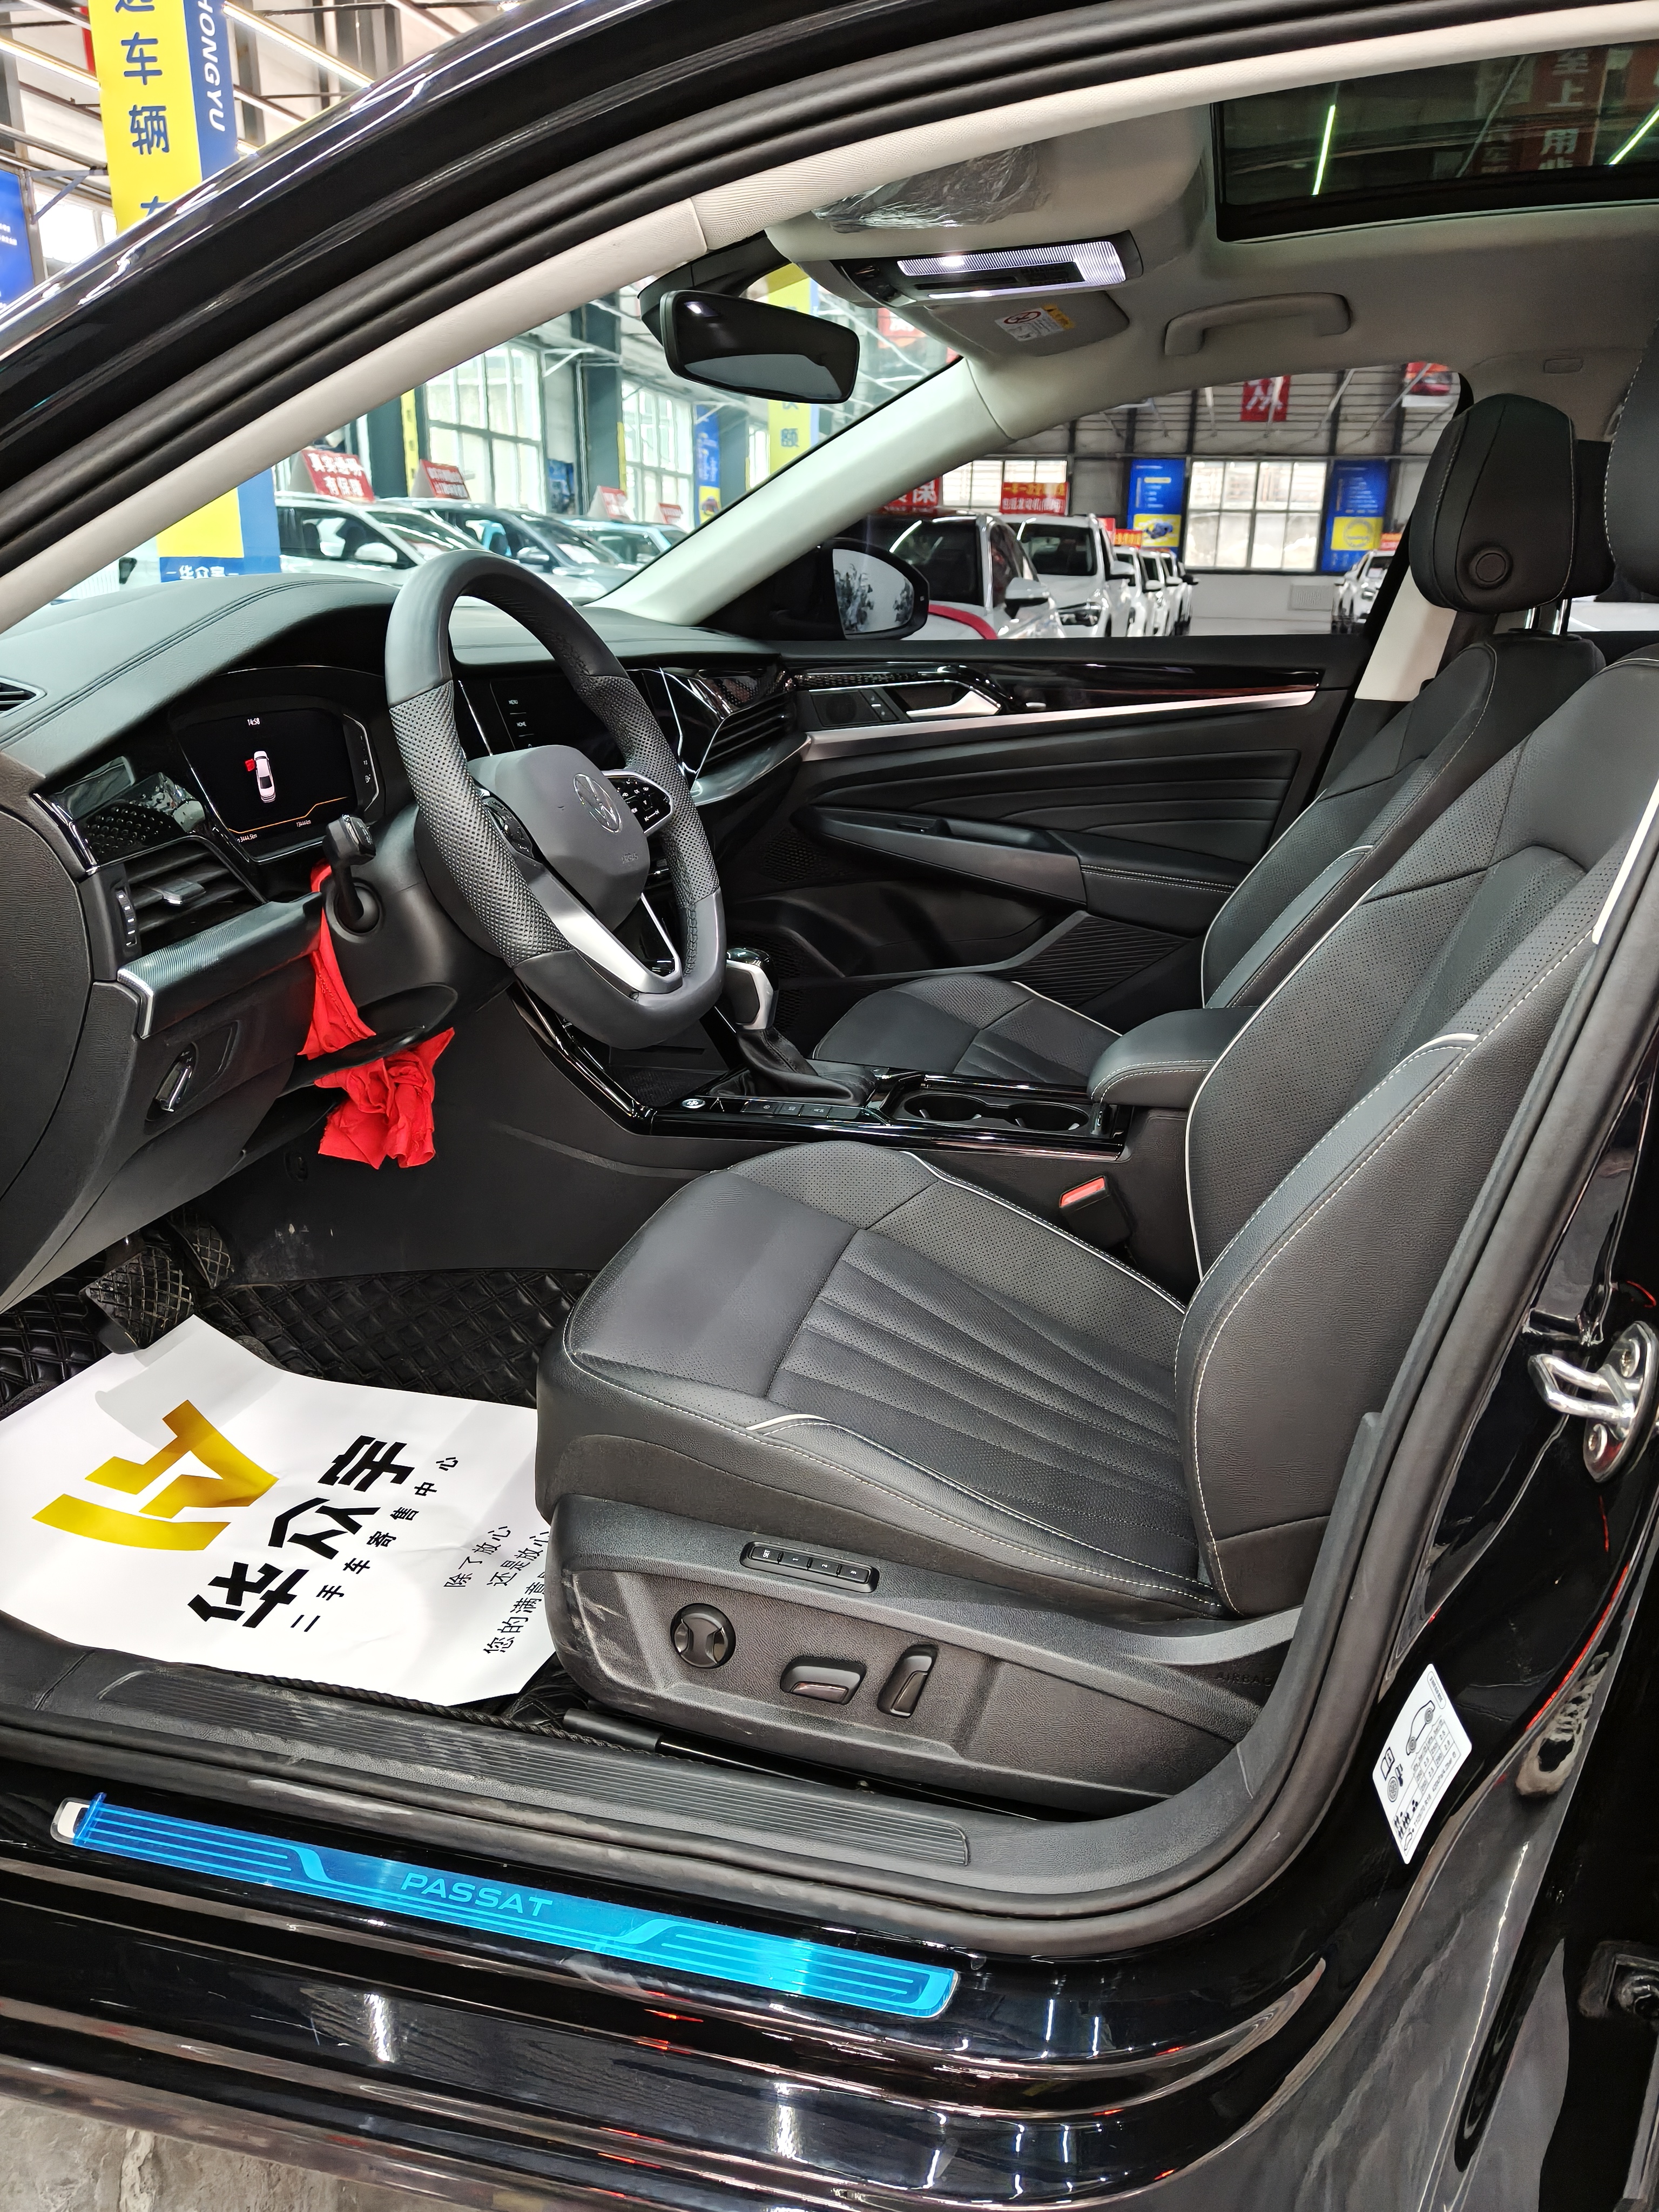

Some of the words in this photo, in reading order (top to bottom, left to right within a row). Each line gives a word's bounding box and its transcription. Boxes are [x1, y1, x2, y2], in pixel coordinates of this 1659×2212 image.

[187, 1435, 415, 1628] 华众宇
[290, 1456, 459, 1632] 二手车寄售中心
[443, 1526, 511, 1587] 除了放心
[486, 1531, 549, 1587] 还是放心
[401, 1872, 553, 1917] PASSAT
